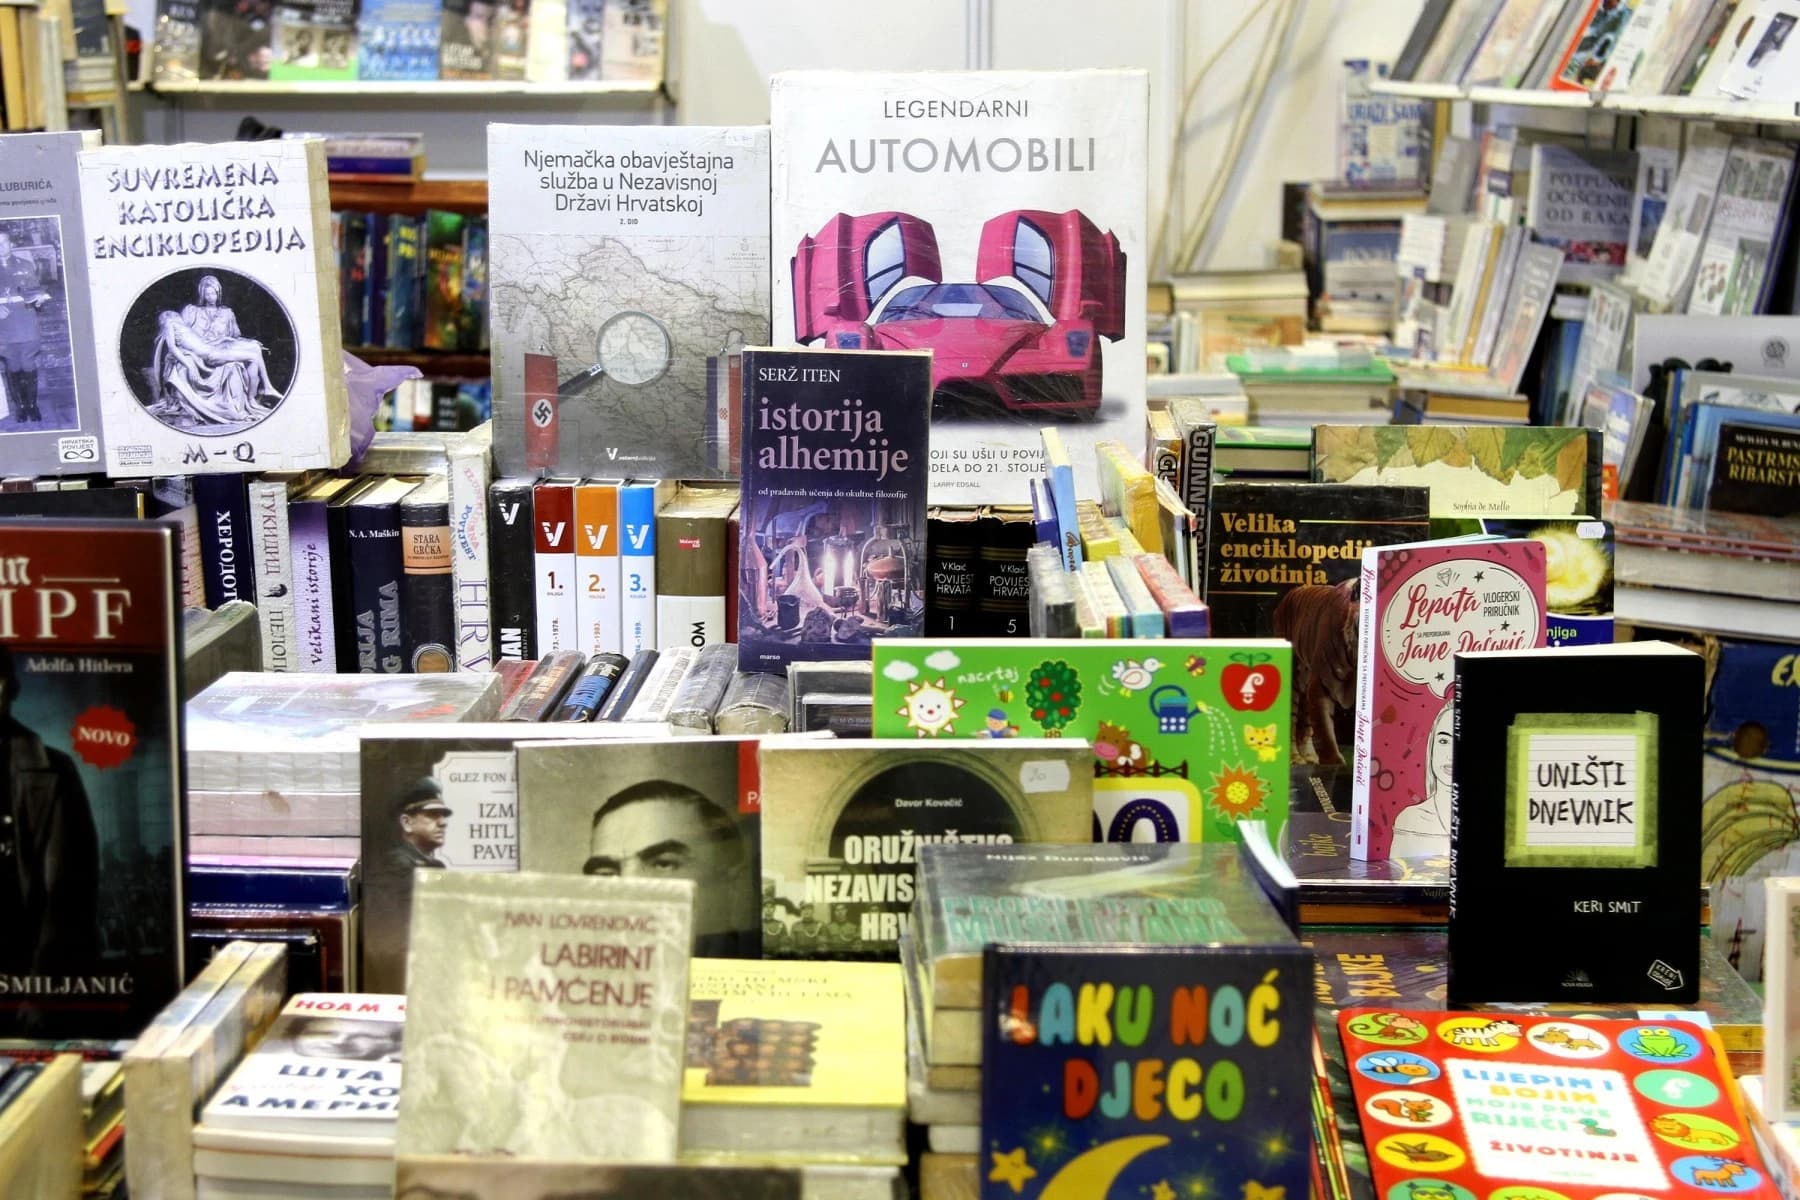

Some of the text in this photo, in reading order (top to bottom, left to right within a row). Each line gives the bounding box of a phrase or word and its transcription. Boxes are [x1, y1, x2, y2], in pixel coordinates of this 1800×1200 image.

[884, 100, 1029, 119] LEGENDARNI
[524, 150, 734, 173] Njemačka obavještajna
[815, 137, 1095, 173] AUTOMOBILI
[107, 161, 279, 193] SUVREMENA
[540, 171, 718, 195] služba u Nezavisnoj
[118, 192, 276, 225] KATOLIČKA
[555, 193, 704, 216] Državi Hrvatskoj
[94, 227, 306, 260] ENCIKLOPEDIJA
[759, 366, 841, 383] SERŽ ITEN
[759, 397, 884, 442] istorija
[759, 435, 909, 482] alhemije
[928, 450, 948, 460] OJI
[953, 450, 968, 460] SU
[972, 447, 996, 460] UŠLI
[1000, 450, 1008, 460] U
[928, 464, 959, 473] DELA
[965, 464, 982, 473] DO
[987, 464, 1002, 473] 21.
[758, 488, 768, 496] od
[770, 488, 806, 498] pradavnih
[809, 489, 833, 498] učenja
[846, 490, 875, 498] okultne
[876, 490, 909, 499] filozofije
[457, 504, 477, 561] POVIJEST
[1220, 512, 1297, 534] Velika
[261, 491, 281, 576] ТУКИДИД
[349, 528, 400, 539] N. A. Maškin
[413, 534, 440, 544] STARA
[216, 510, 239, 600] ХЕРОДОТ
[413, 543, 443, 555] GRČKA
[1220, 538, 1373, 564] enciklopedi
[303, 543, 325, 594] istorije
[941, 562, 967, 571] V Klaić
[1000, 564, 1026, 574] V Klaić
[1220, 562, 1329, 589] životinja
[547, 571, 564, 590] 1.
[589, 574, 605, 592] 2.
[629, 574, 647, 592] 3.
[934, 573, 974, 585] POVIJEST
[936, 584, 972, 595] HRVATA
[993, 585, 1031, 597] HRVATA
[1483, 590, 1521, 603] VLOGERSKI
[379, 579, 401, 648] RIMA
[1399, 583, 1482, 630] Lepota
[1483, 604, 1520, 617] PRIRUČNIK
[306, 598, 324, 665] Velikani
[949, 616, 954, 631] 1
[1007, 619, 1018, 634] 5
[759, 654, 781, 662] marso
[1396, 632, 1450, 669] Jane
[25, 657, 134, 673] Adolfa Hitlera
[957, 665, 1021, 684] nacrtaj
[77, 728, 131, 747] NOVO
[449, 773, 506, 783] GLEZ FON
[1538, 755, 1627, 788] UNIŠTI
[479, 803, 515, 818] IZM
[895, 797, 963, 808] Davor Kovačić
[1529, 797, 1634, 826] DNEVNIK
[470, 824, 515, 839] HITL
[473, 844, 517, 860] PAVE
[986, 853, 1038, 864] Nijaz
[804, 873, 914, 903] NEZAVIS
[1573, 900, 1643, 914] KERI SMIT
[504, 911, 656, 933] IVAN LOVRENOVIĆ
[541, 943, 657, 971] LABIRINT
[1336, 953, 1402, 998] BAJKE
[504, 974, 655, 1009] PAMĆENJE
[294, 1000, 381, 1013] НОАМ
[1006, 981, 1155, 1048] LAKU
[1170, 968, 1281, 1048] NOĆ
[279, 1064, 385, 1081] ШТА
[1462, 1068, 1614, 1092] LIJEPIM I
[1063, 1057, 1246, 1122] DJECO
[1489, 1084, 1598, 1104] BOJIM
[1466, 1097, 1612, 1119] MOJE PRVE
[1470, 1111, 1569, 1132] RIJEČI
[1489, 1139, 1640, 1163] ŽIVOTINJE
